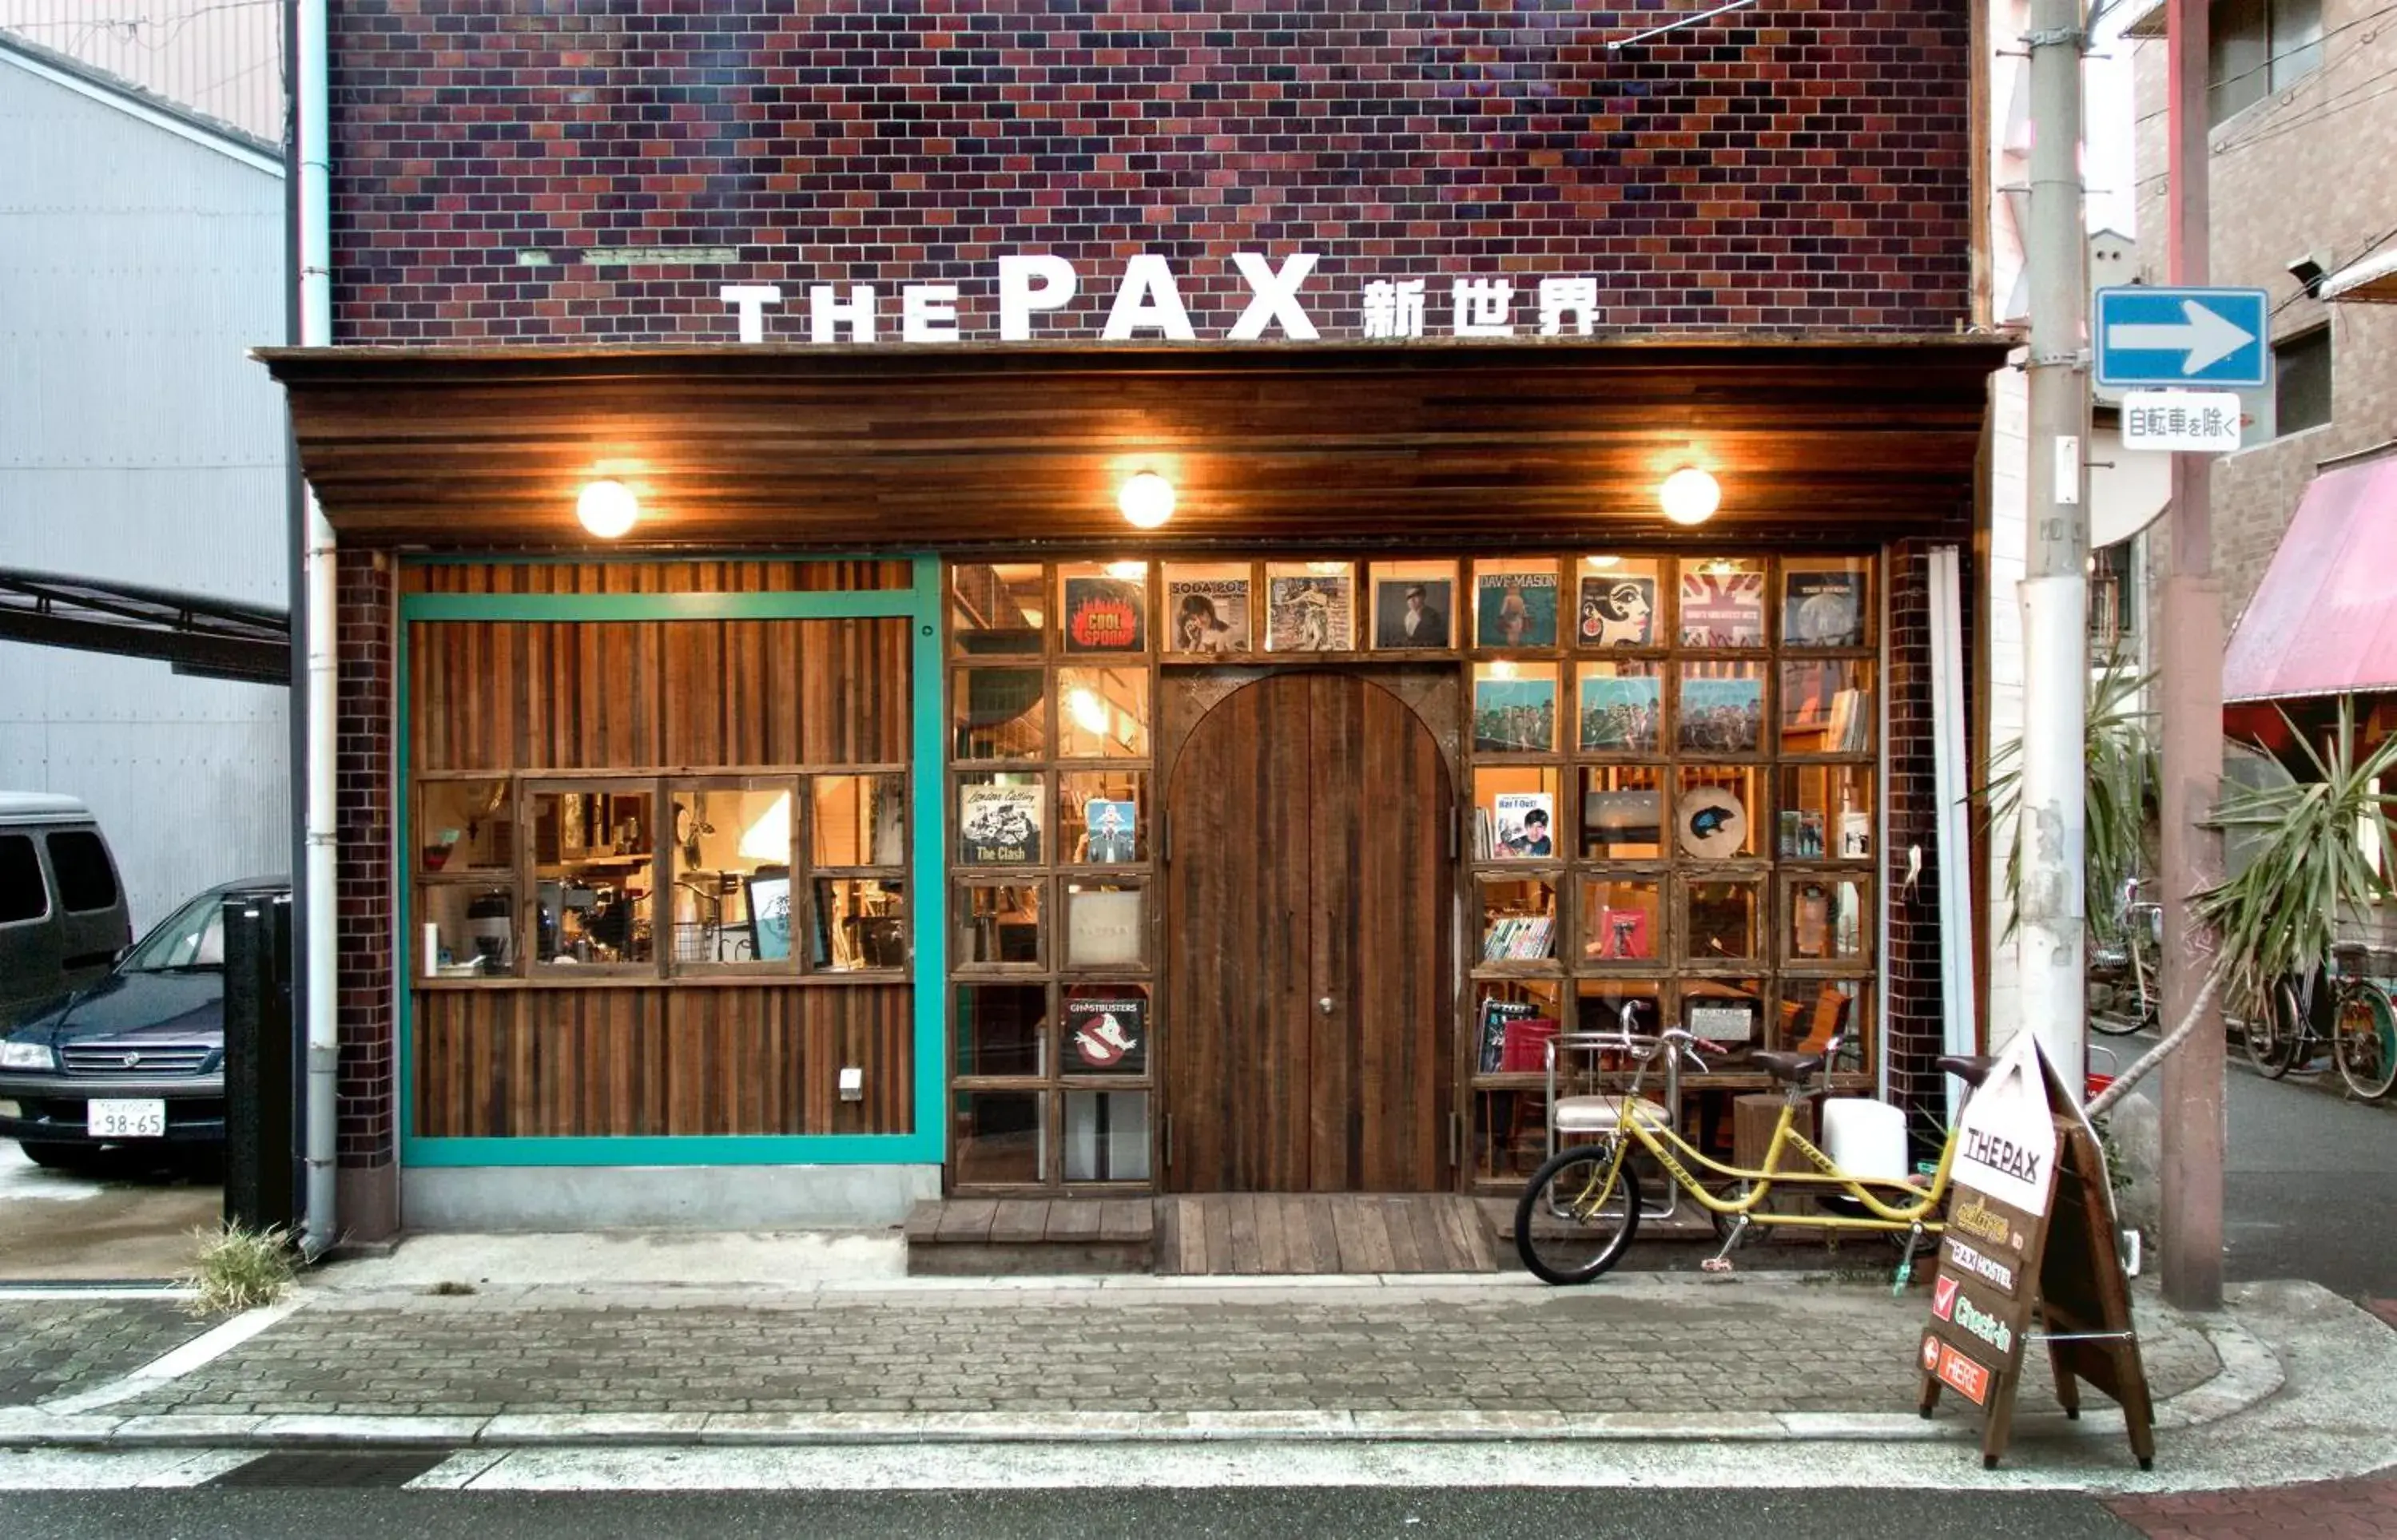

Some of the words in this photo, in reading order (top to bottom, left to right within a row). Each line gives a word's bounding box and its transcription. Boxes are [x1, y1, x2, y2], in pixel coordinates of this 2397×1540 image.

[720, 285, 959, 343] THE
[998, 252, 1321, 342] PAX
[1363, 277, 1599, 338] 新世界
[2129, 407, 2236, 437] 自転車を除く
[1480, 574, 1509, 587] DAVE
[1515, 574, 1557, 587] MASON
[1087, 613, 1121, 629] COOL
[977, 846, 996, 860] The
[997, 846, 1025, 860] Clash
[105, 1115, 160, 1133] 98-65
[1946, 1353, 1980, 1394] HERE
